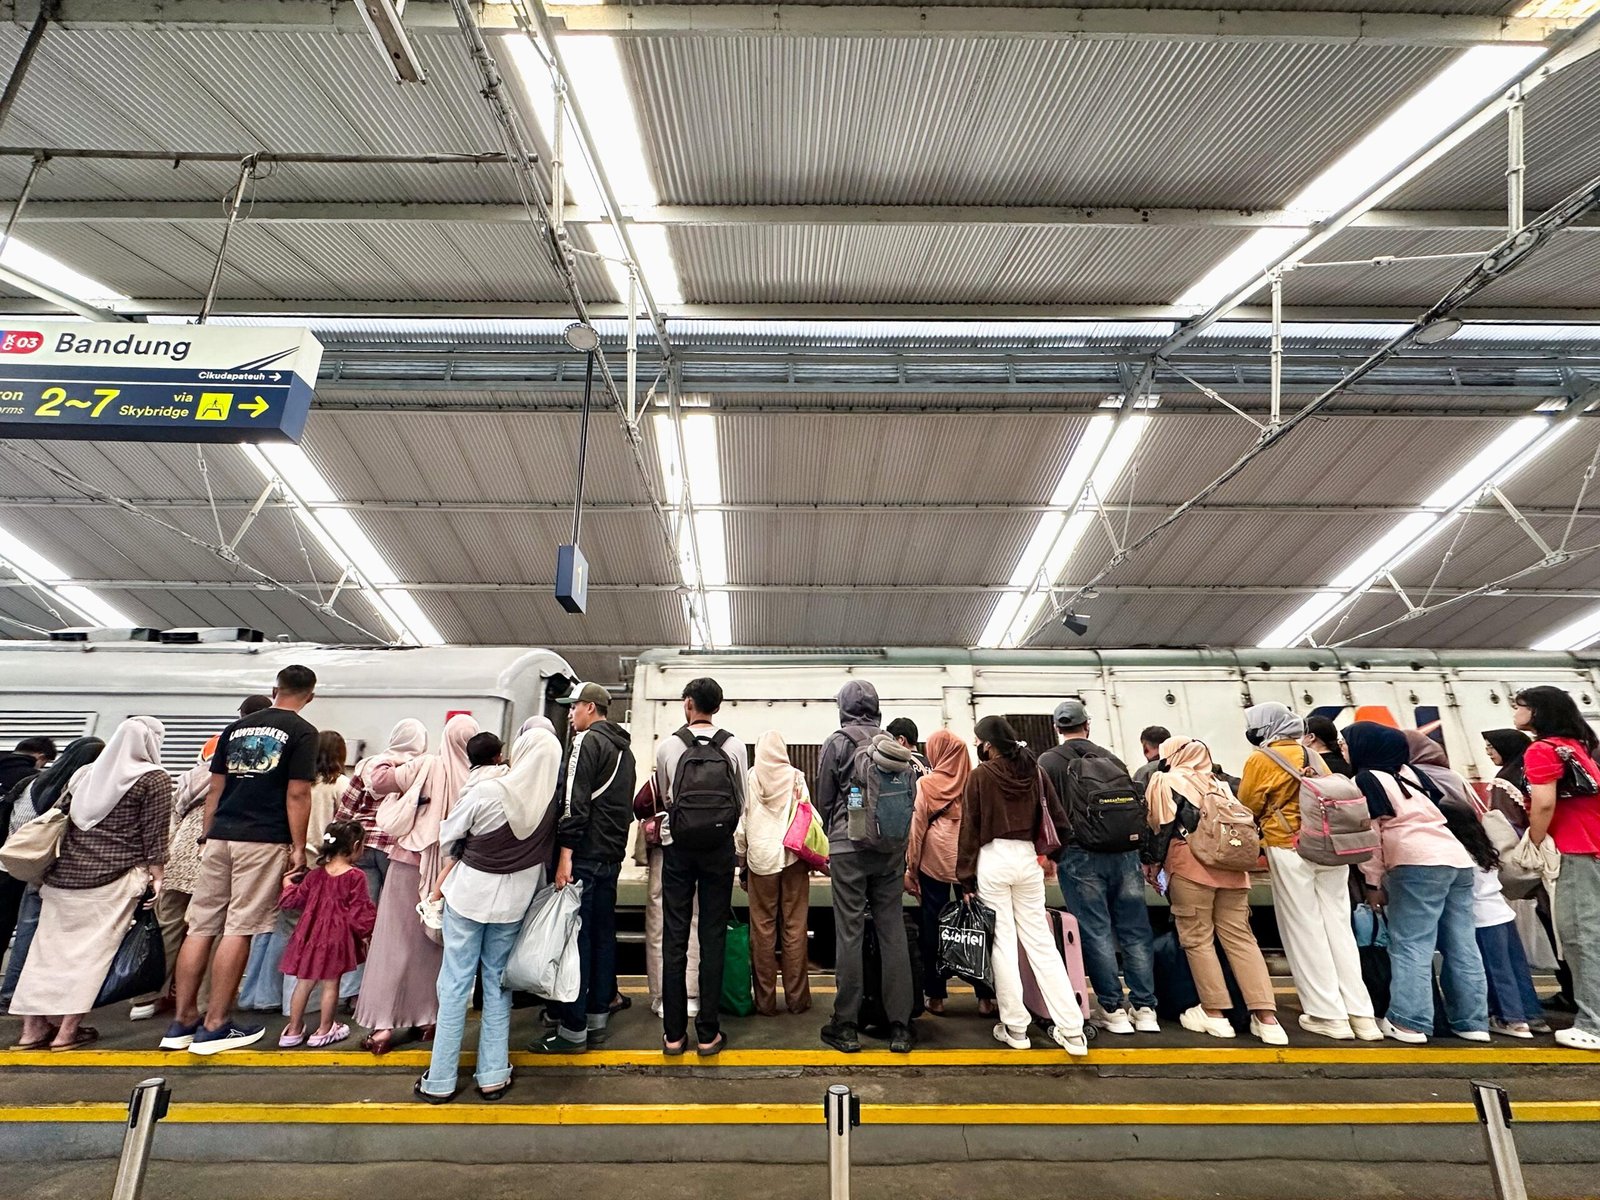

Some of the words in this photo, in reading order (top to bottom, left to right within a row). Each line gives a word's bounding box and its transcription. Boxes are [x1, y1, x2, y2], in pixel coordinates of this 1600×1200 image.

[17, 337, 39, 348] 03
[54, 332, 191, 361] Bandung
[198, 371, 265, 381] Cikudapateuh
[173, 392, 193, 402] via
[119, 405, 189, 420] Skybridge
